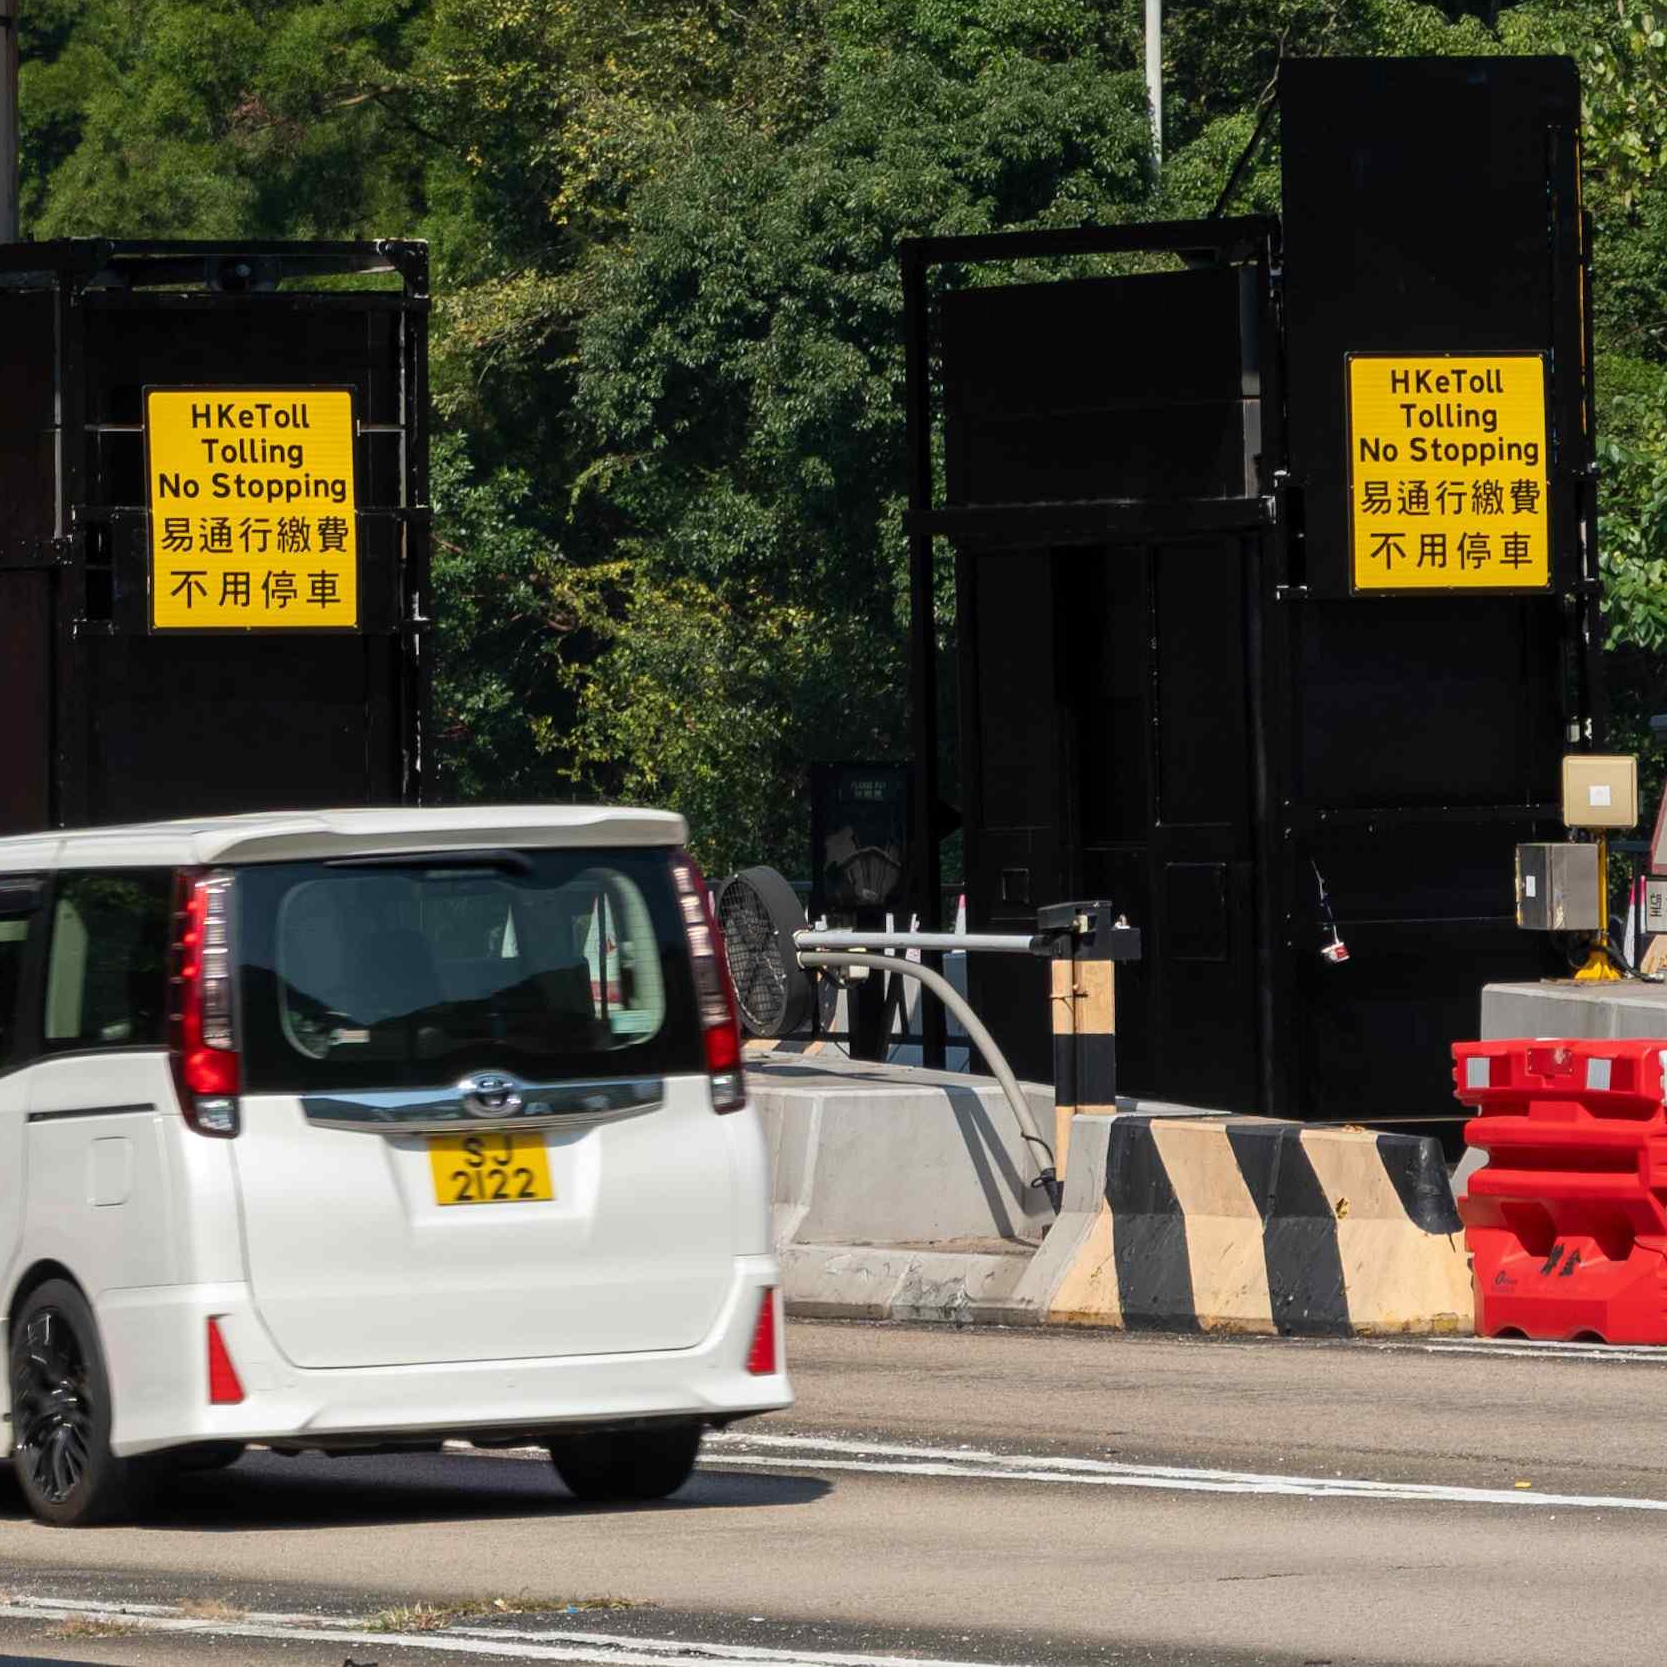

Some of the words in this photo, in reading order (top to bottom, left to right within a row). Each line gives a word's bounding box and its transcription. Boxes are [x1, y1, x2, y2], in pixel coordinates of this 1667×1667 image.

[1391, 368, 1504, 394] HKeToll
[191, 403, 310, 429] HKeToll
[1399, 403, 1498, 434] Tolling
[201, 438, 304, 470] Tolling
[1359, 437, 1398, 462] No
[1409, 436, 1539, 467] Stopping
[159, 473, 200, 499] No
[211, 472, 347, 504] Stopping
[1360, 478, 1541, 516] 易通行繳費
[161, 515, 349, 554] 易通行繳費
[1370, 531, 1533, 571] 不用停車
[170, 569, 341, 609] 不用停車
[463, 1135, 514, 1168] SJ
[451, 1167, 537, 1201] 2122
